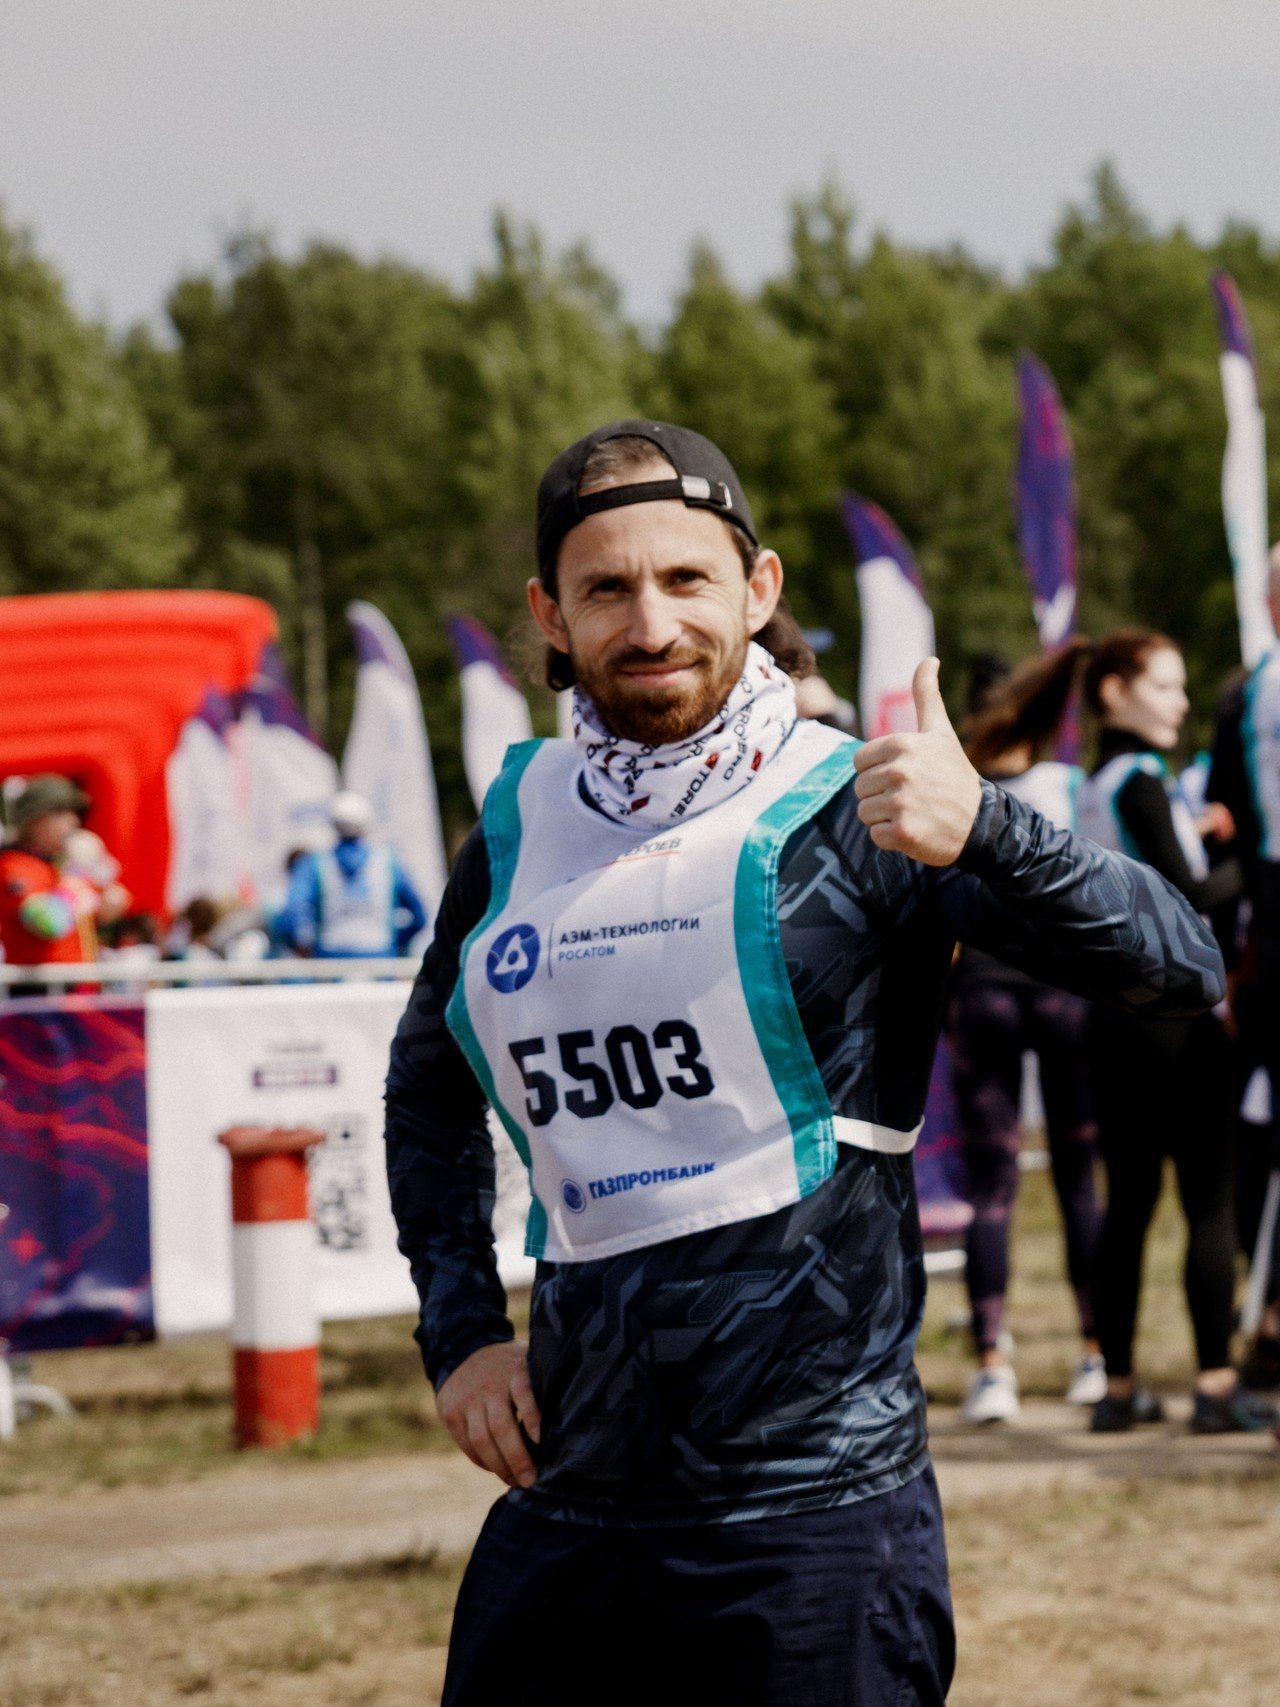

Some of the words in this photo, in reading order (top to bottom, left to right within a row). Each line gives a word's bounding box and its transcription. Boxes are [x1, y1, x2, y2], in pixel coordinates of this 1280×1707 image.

[669, 771, 711, 818] TORE
[559, 917, 700, 945] АЭМ-ТЕХНОЛОГИИ
[557, 945, 616, 962] РОСАТОМ
[508, 1019, 715, 1128] 5503
[588, 1162, 716, 1199] ГАЗПРОМБАНК
